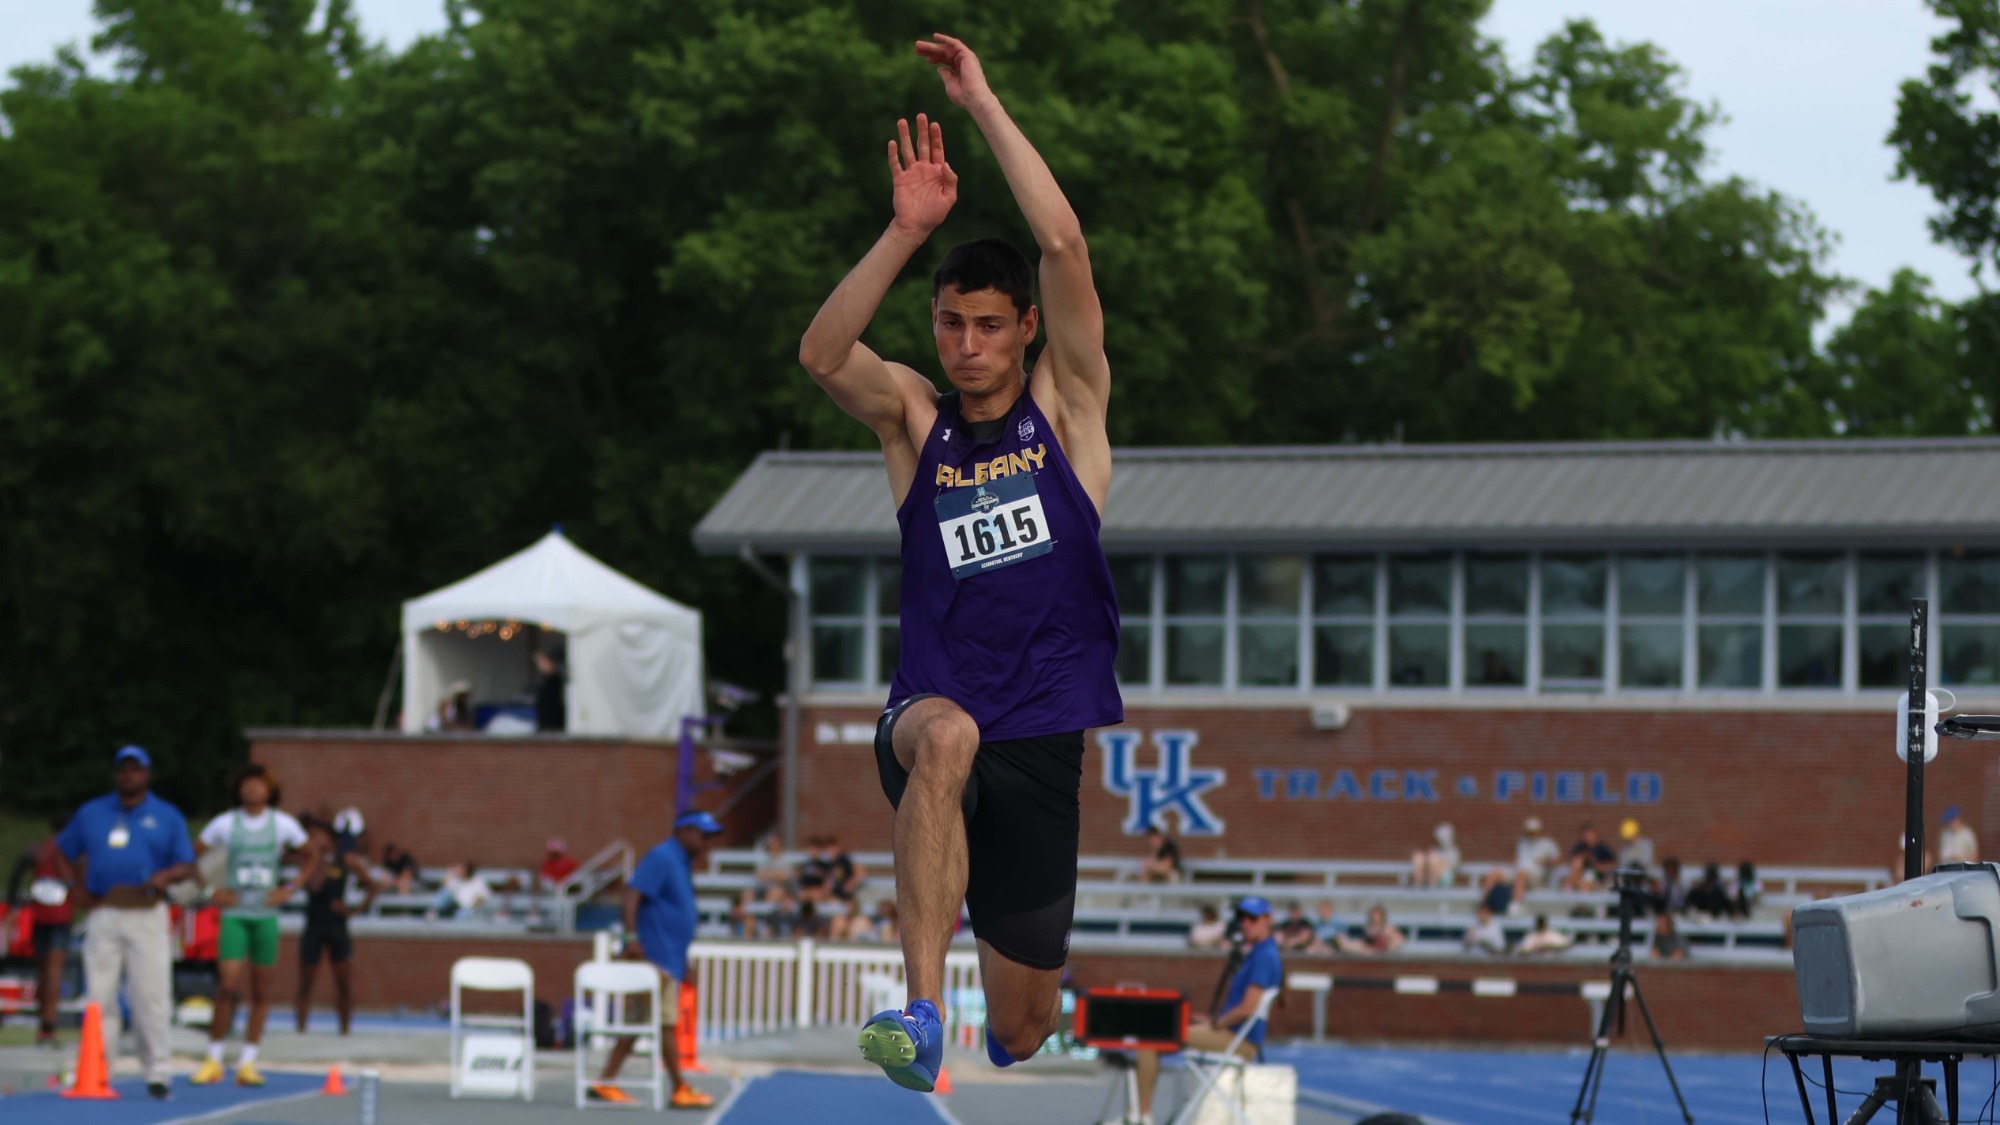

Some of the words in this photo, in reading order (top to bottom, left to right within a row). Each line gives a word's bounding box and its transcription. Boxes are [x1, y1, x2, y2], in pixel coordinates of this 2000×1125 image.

[935, 443, 1047, 488] ALBANY
[954, 505, 1038, 562] 1615
[1098, 730, 1226, 836] UK
[1253, 769, 1440, 802] TRACK
[1495, 770, 1663, 804] FIELD
